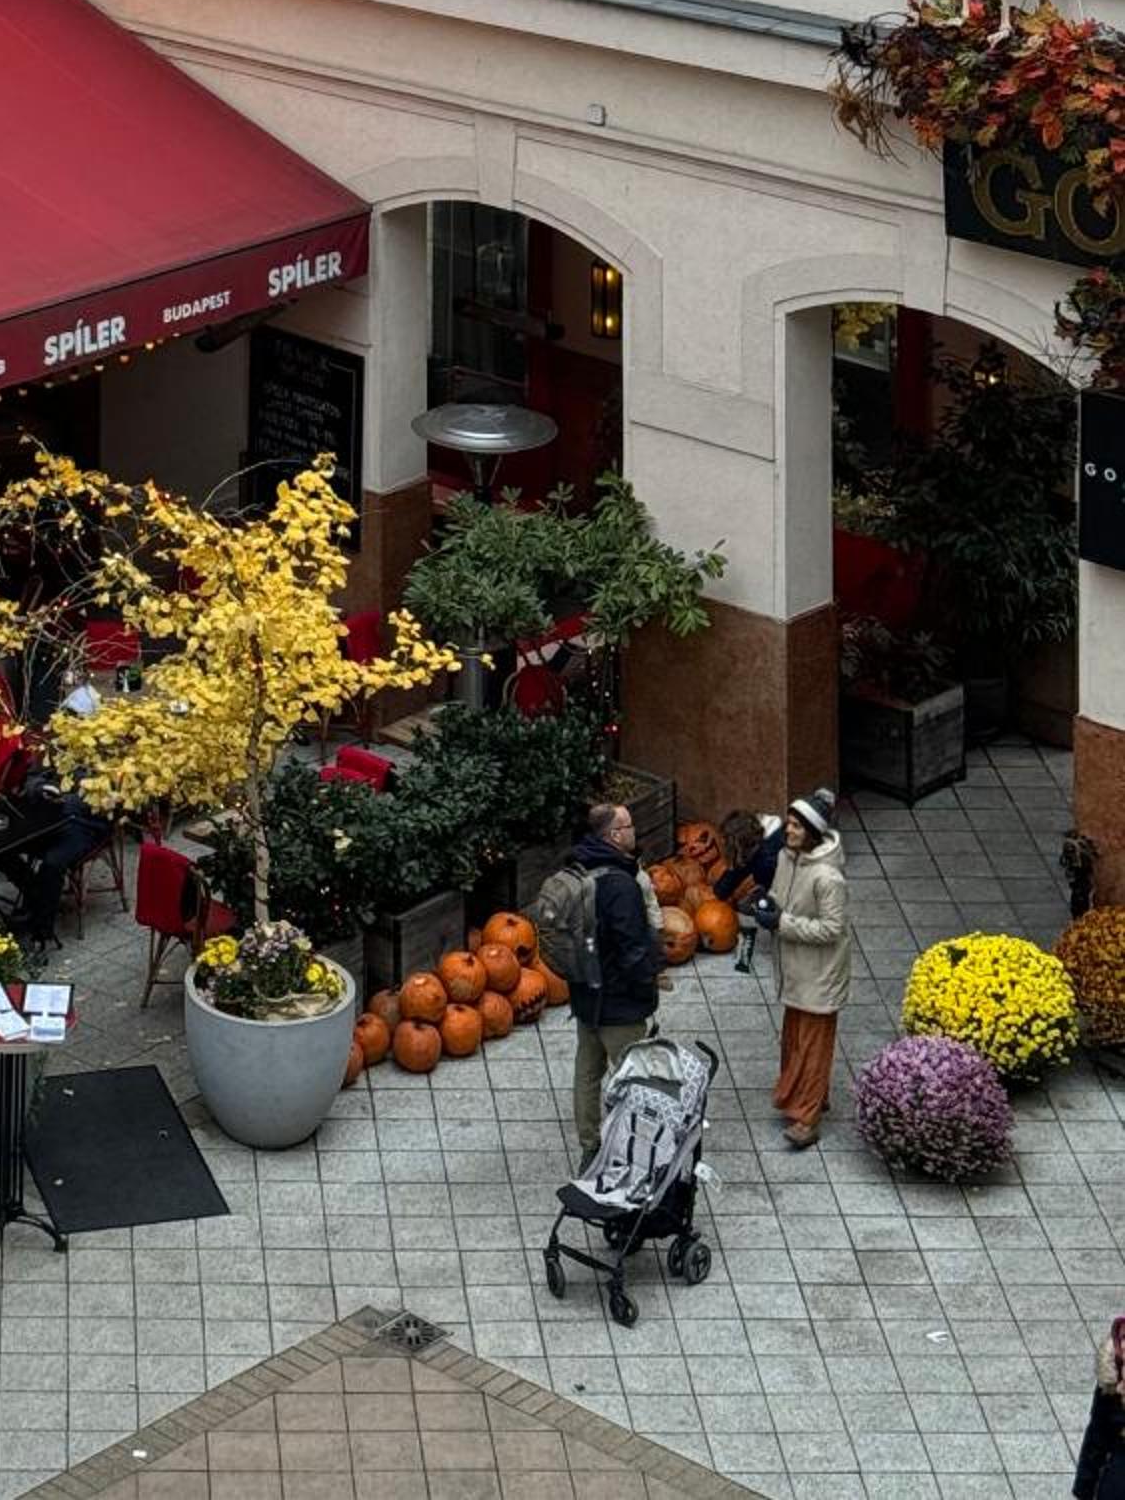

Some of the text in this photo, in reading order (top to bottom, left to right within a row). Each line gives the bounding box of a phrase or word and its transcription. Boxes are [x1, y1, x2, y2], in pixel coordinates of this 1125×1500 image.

[43, 315, 126, 367] SPÍLER
[162, 290, 231, 324] BUDAPEST
[267, 250, 342, 297] SPÍLER
